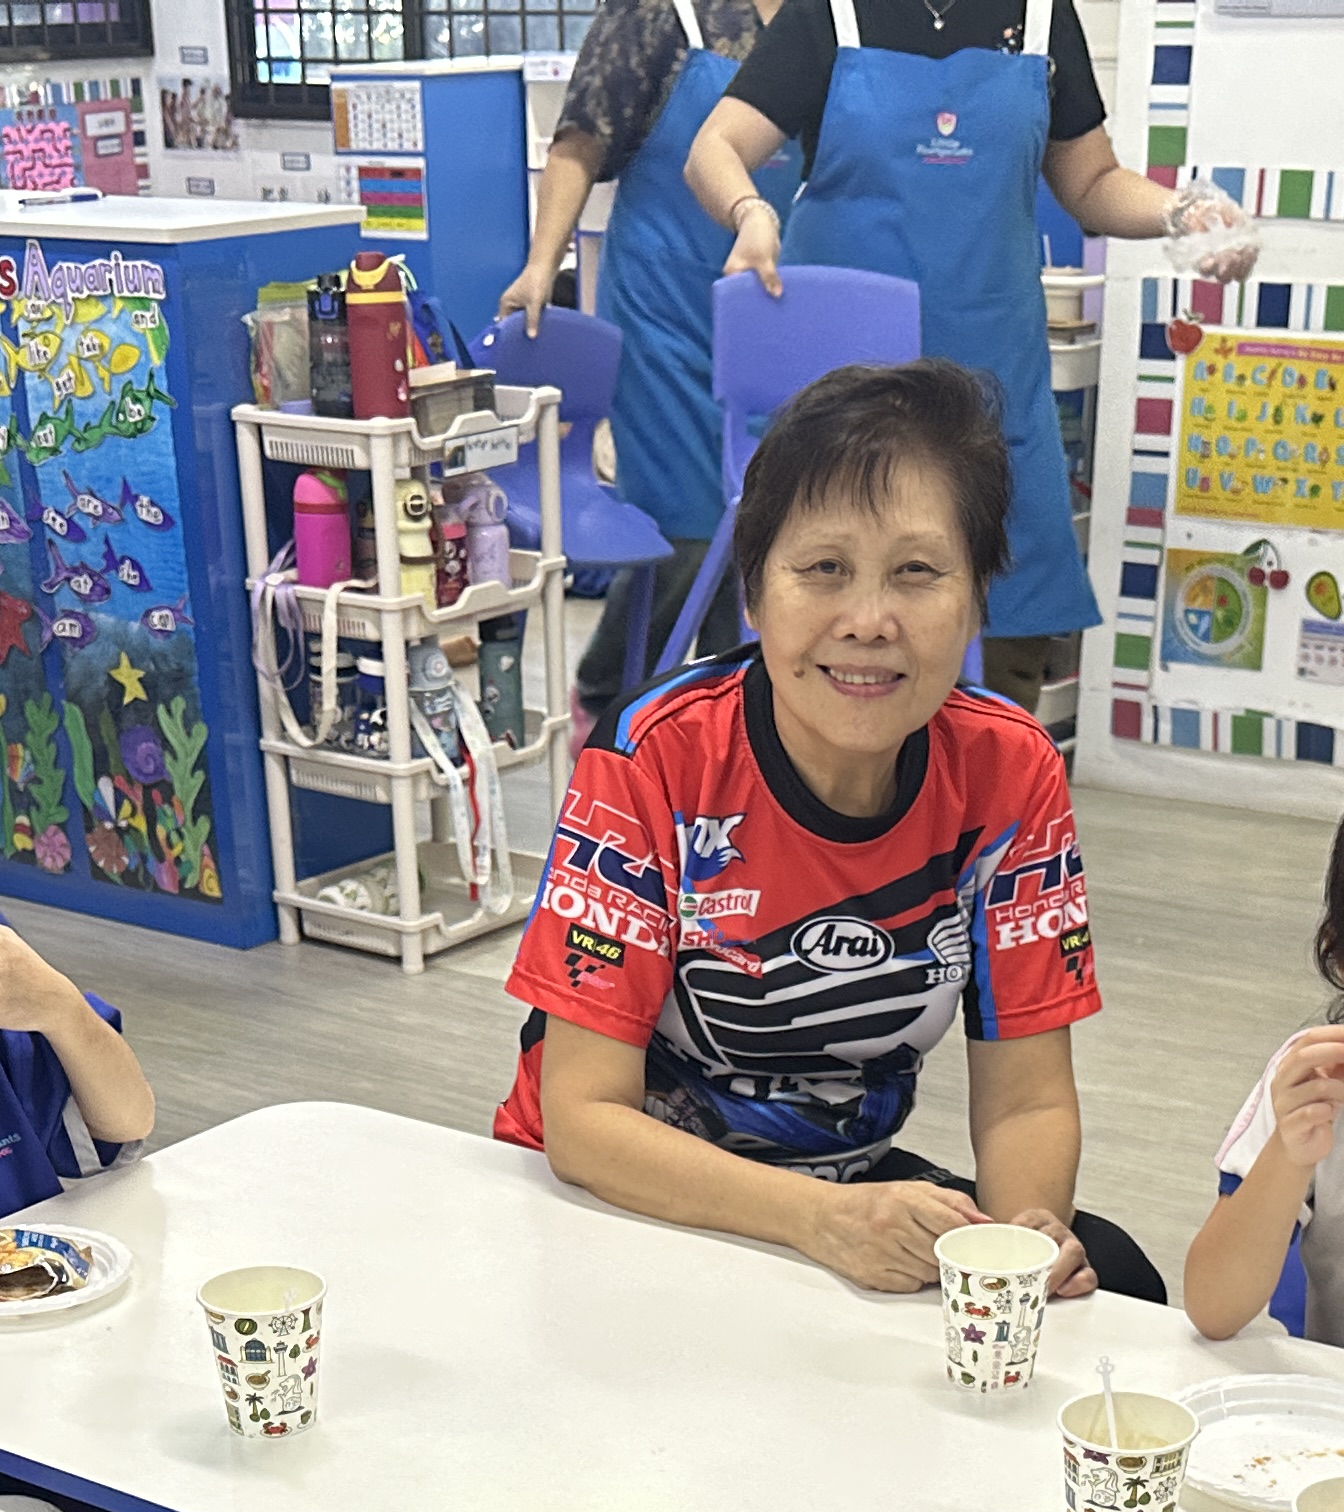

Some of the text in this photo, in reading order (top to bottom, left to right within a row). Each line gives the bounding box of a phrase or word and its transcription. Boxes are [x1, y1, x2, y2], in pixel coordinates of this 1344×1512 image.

[24, 240, 165, 322] Aquarium
[133, 303, 157, 325] and
[28, 341, 50, 365] like
[1193, 360, 1206, 381] A
[1252, 365, 1268, 386] C
[1282, 367, 1296, 387] D
[1191, 398, 1204, 416] H
[1227, 400, 1236, 419] I
[1257, 402, 1269, 422] J
[1295, 405, 1311, 424] K
[1216, 436, 1230, 455] O
[1273, 440, 1290, 461] Q
[1219, 471, 1234, 491] V
[1252, 475, 1274, 494] W
[1295, 478, 1308, 497] X
[1332, 481, 1344, 501] Y
[77, 496, 101, 514] are
[138, 498, 161, 525] the
[44, 510, 67, 533] see
[72, 576, 90, 594] at
[118, 562, 140, 585] she
[56, 621, 81, 636] am
[151, 610, 173, 629] can
[698, 892, 754, 917] Castrol
[811, 923, 881, 959] Arai
